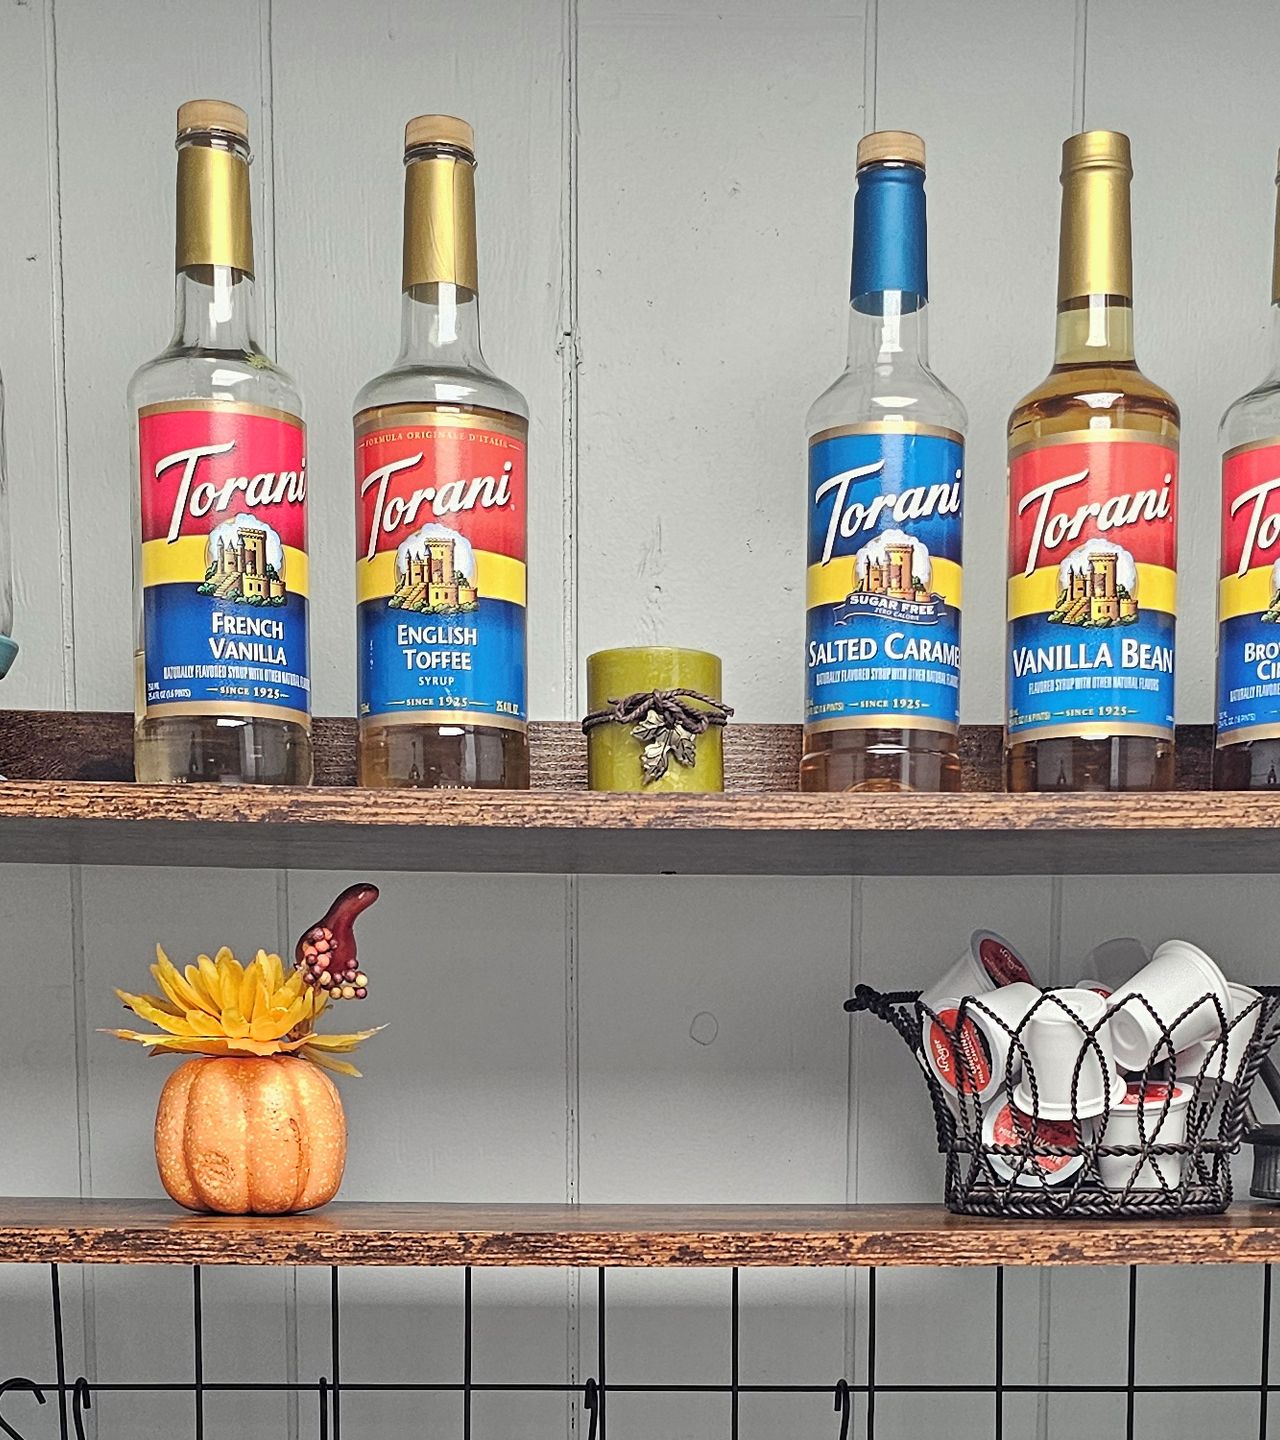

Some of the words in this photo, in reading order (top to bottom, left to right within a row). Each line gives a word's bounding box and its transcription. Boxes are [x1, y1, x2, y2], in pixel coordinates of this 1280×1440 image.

[365, 433, 403, 447] FORMULA
[407, 431, 465, 440] ORIGINALE
[469, 432, 508, 448] D'ITALIA
[155, 440, 307, 544] Torani
[361, 452, 512, 562] Torani
[816, 459, 962, 566] Torani
[1018, 469, 1173, 577] Torani
[850, 595, 898, 610] SUGAR
[901, 603, 934, 614] FREE
[874, 607, 892, 615] ZERO
[894, 611, 919, 620] CALORIE
[212, 612, 284, 639] FRENCH
[397, 624, 477, 645] ENGLISH
[208, 637, 287, 665] VANILLA
[402, 648, 472, 670] TOFFEE
[809, 638, 877, 667] SALTED
[884, 632, 960, 669] CARAME
[1013, 643, 1113, 677] VANILLA
[1122, 638, 1172, 673] BEAN
[418, 676, 455, 686] SYRUP
[1092, 677, 1112, 689] OTHER
[1113, 677, 1138, 690] NATURAL
[220, 687, 249, 695] SINCE
[253, 687, 280, 699] 1925
[406, 698, 434, 706] SINCE
[438, 696, 468, 707] 1925
[860, 700, 888, 708] SINCE
[893, 699, 921, 709] 1925
[1098, 706, 1127, 716] 1925
